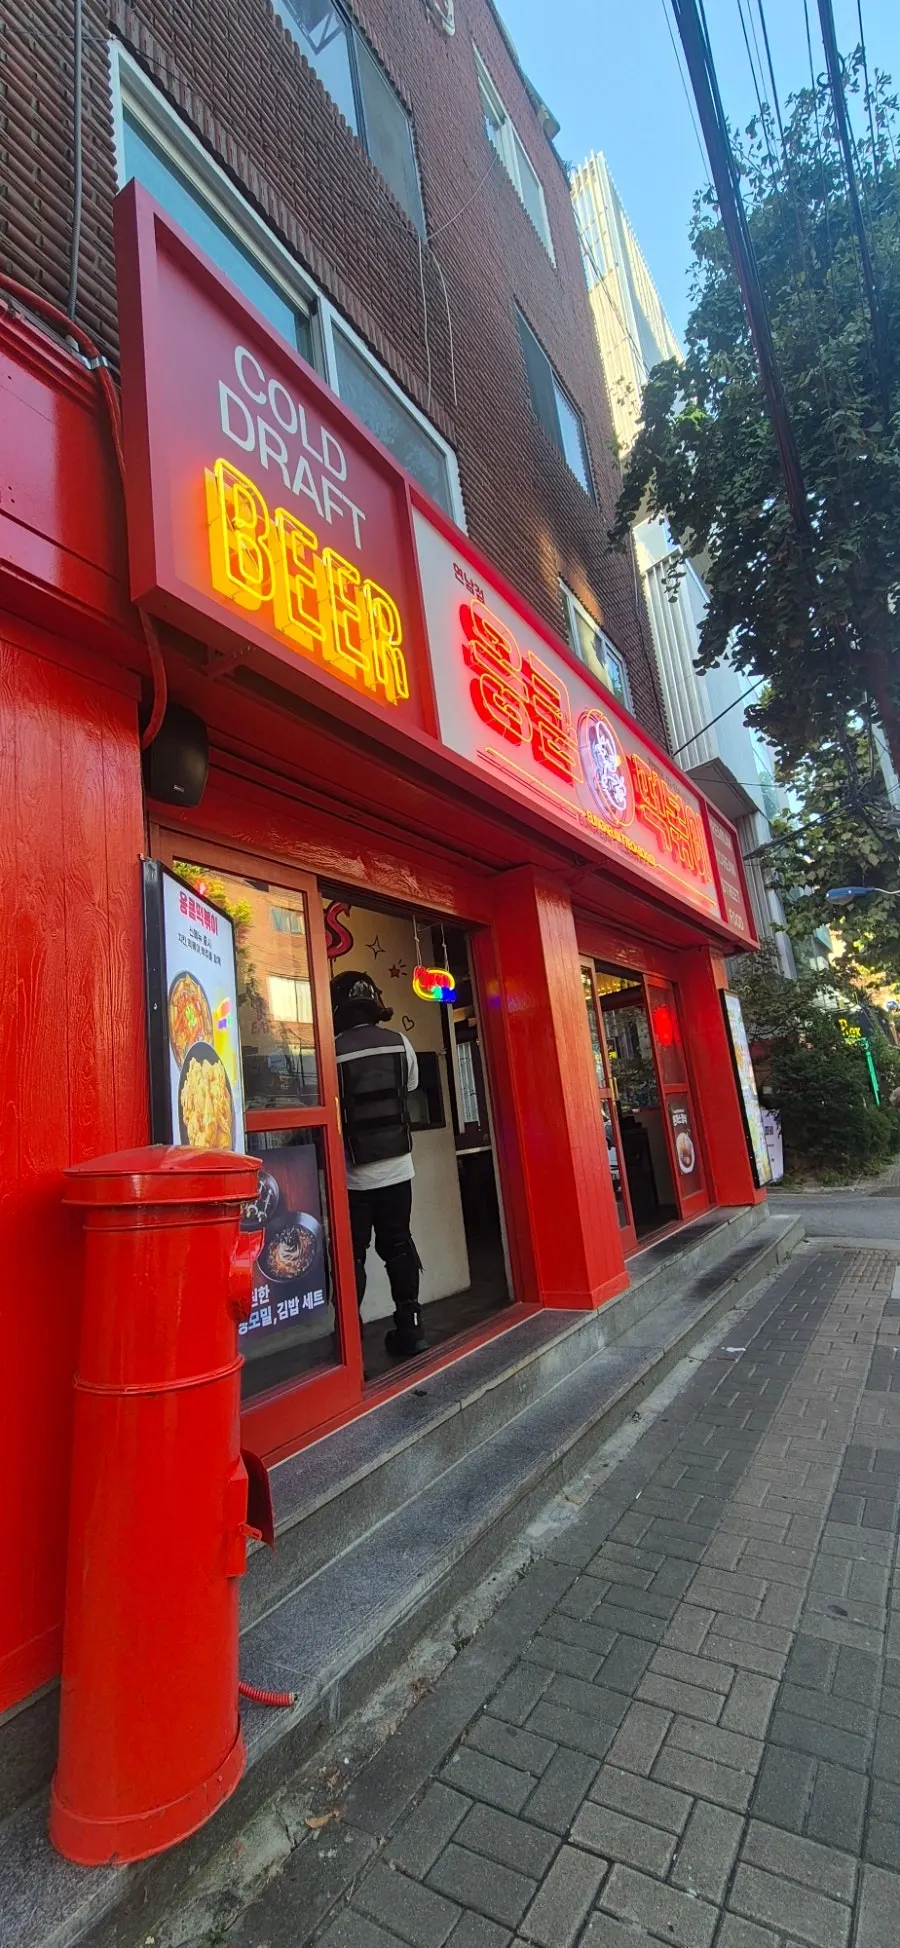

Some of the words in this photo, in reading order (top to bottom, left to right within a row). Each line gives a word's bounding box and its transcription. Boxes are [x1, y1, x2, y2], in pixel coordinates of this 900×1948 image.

[219, 380, 366, 549] DRAFT
[234, 345, 348, 482] COLD
[205, 458, 409, 705] BEER
[453, 562, 485, 605] 연남점
[627, 754, 713, 886] 떡볶이
[728, 908, 744, 931] FOOD
[302, 1289, 325, 1310] 세트
